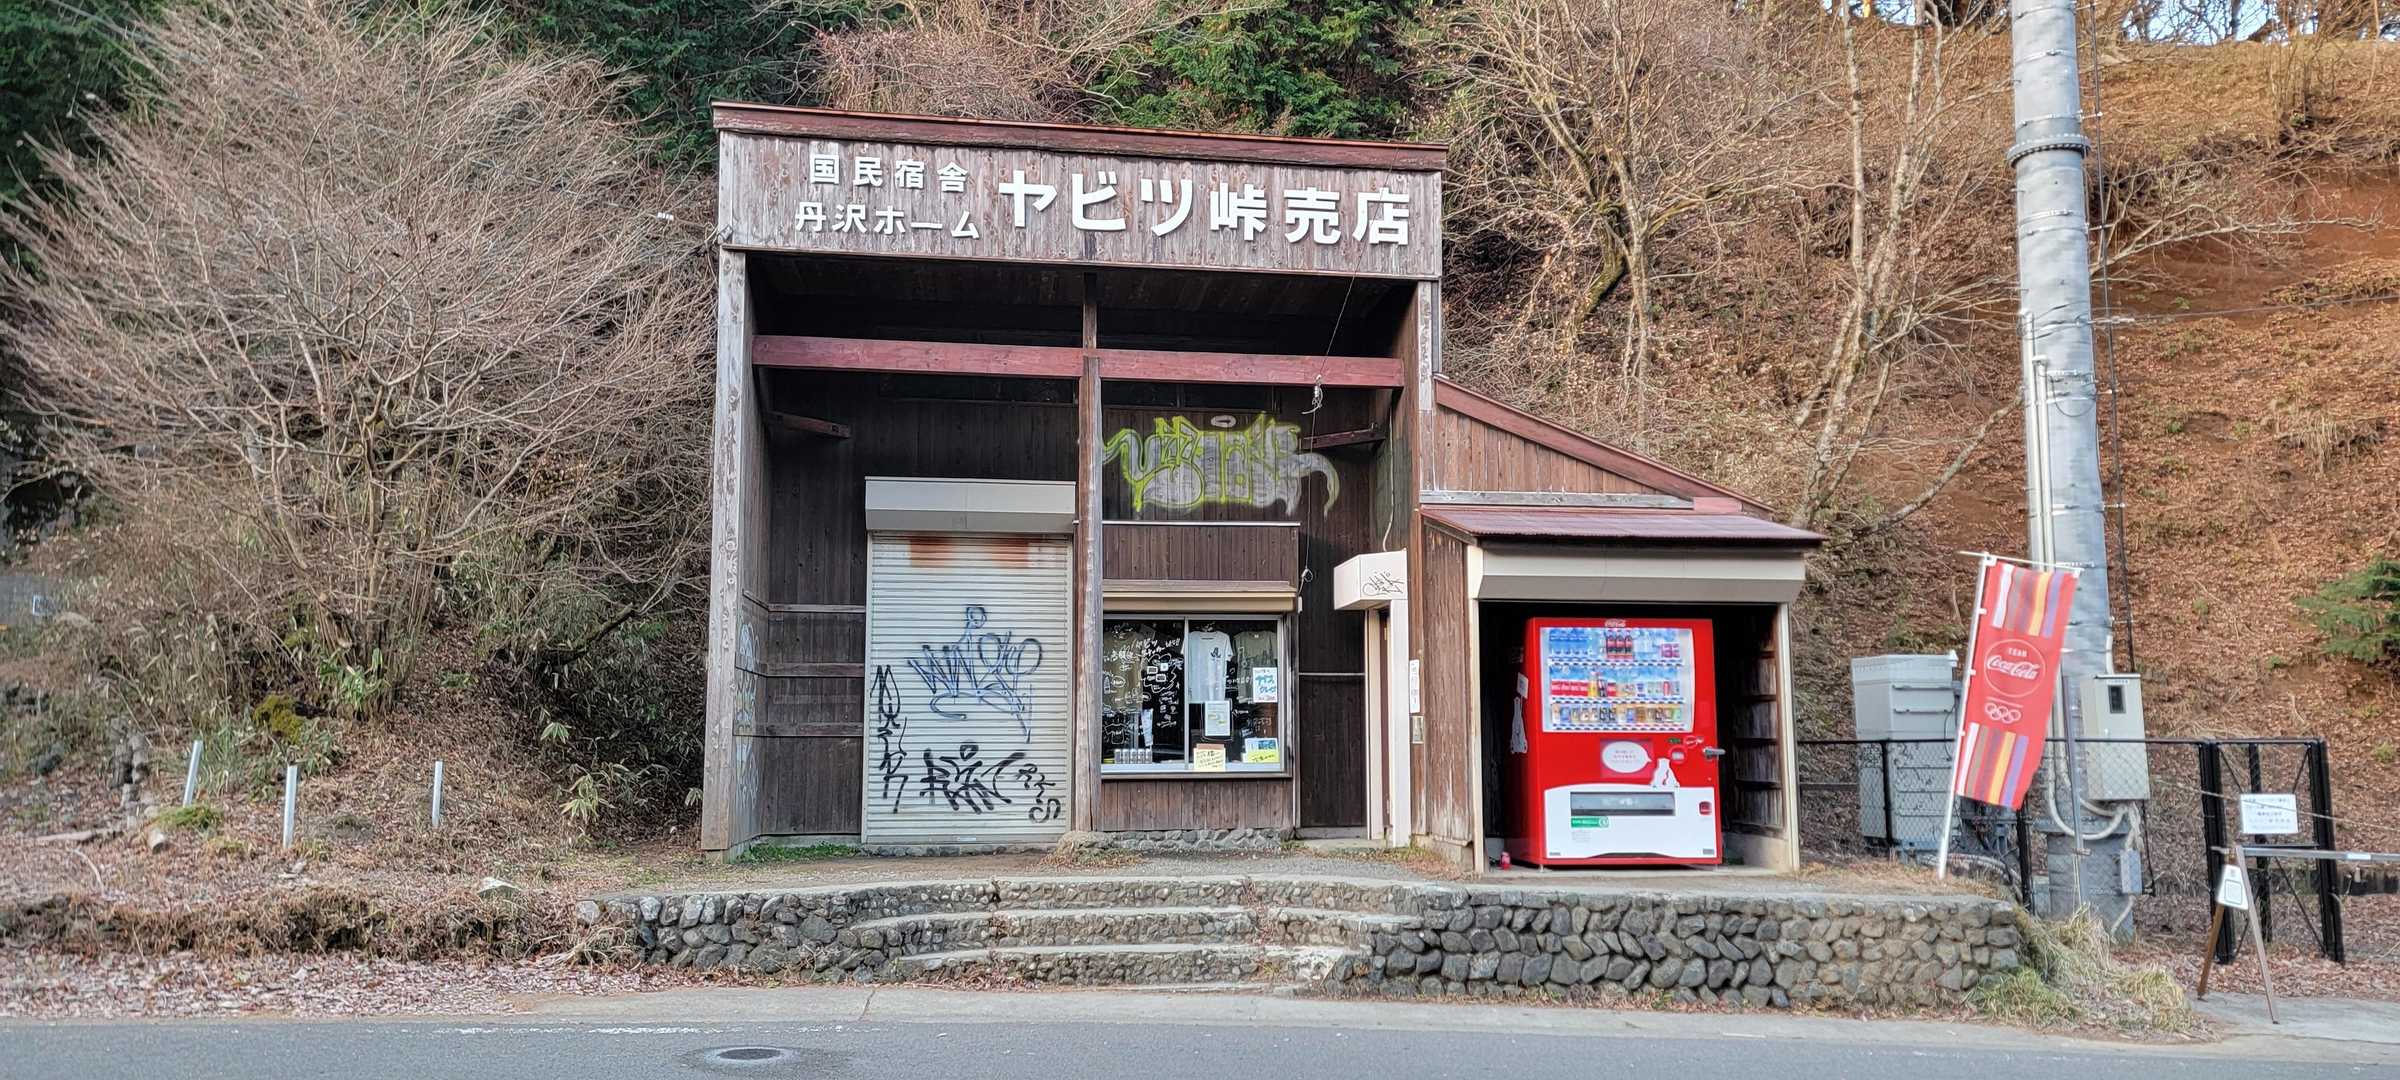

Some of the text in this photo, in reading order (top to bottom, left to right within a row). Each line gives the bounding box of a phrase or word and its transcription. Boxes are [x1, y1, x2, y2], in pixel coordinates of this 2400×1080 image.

[809, 153, 969, 193] 国民宿舎
[795, 201, 980, 239] 丹沢ホーム
[999, 170, 1411, 246] ヤビツ峠売店
[1987, 655, 2040, 680] Coca-Cola
